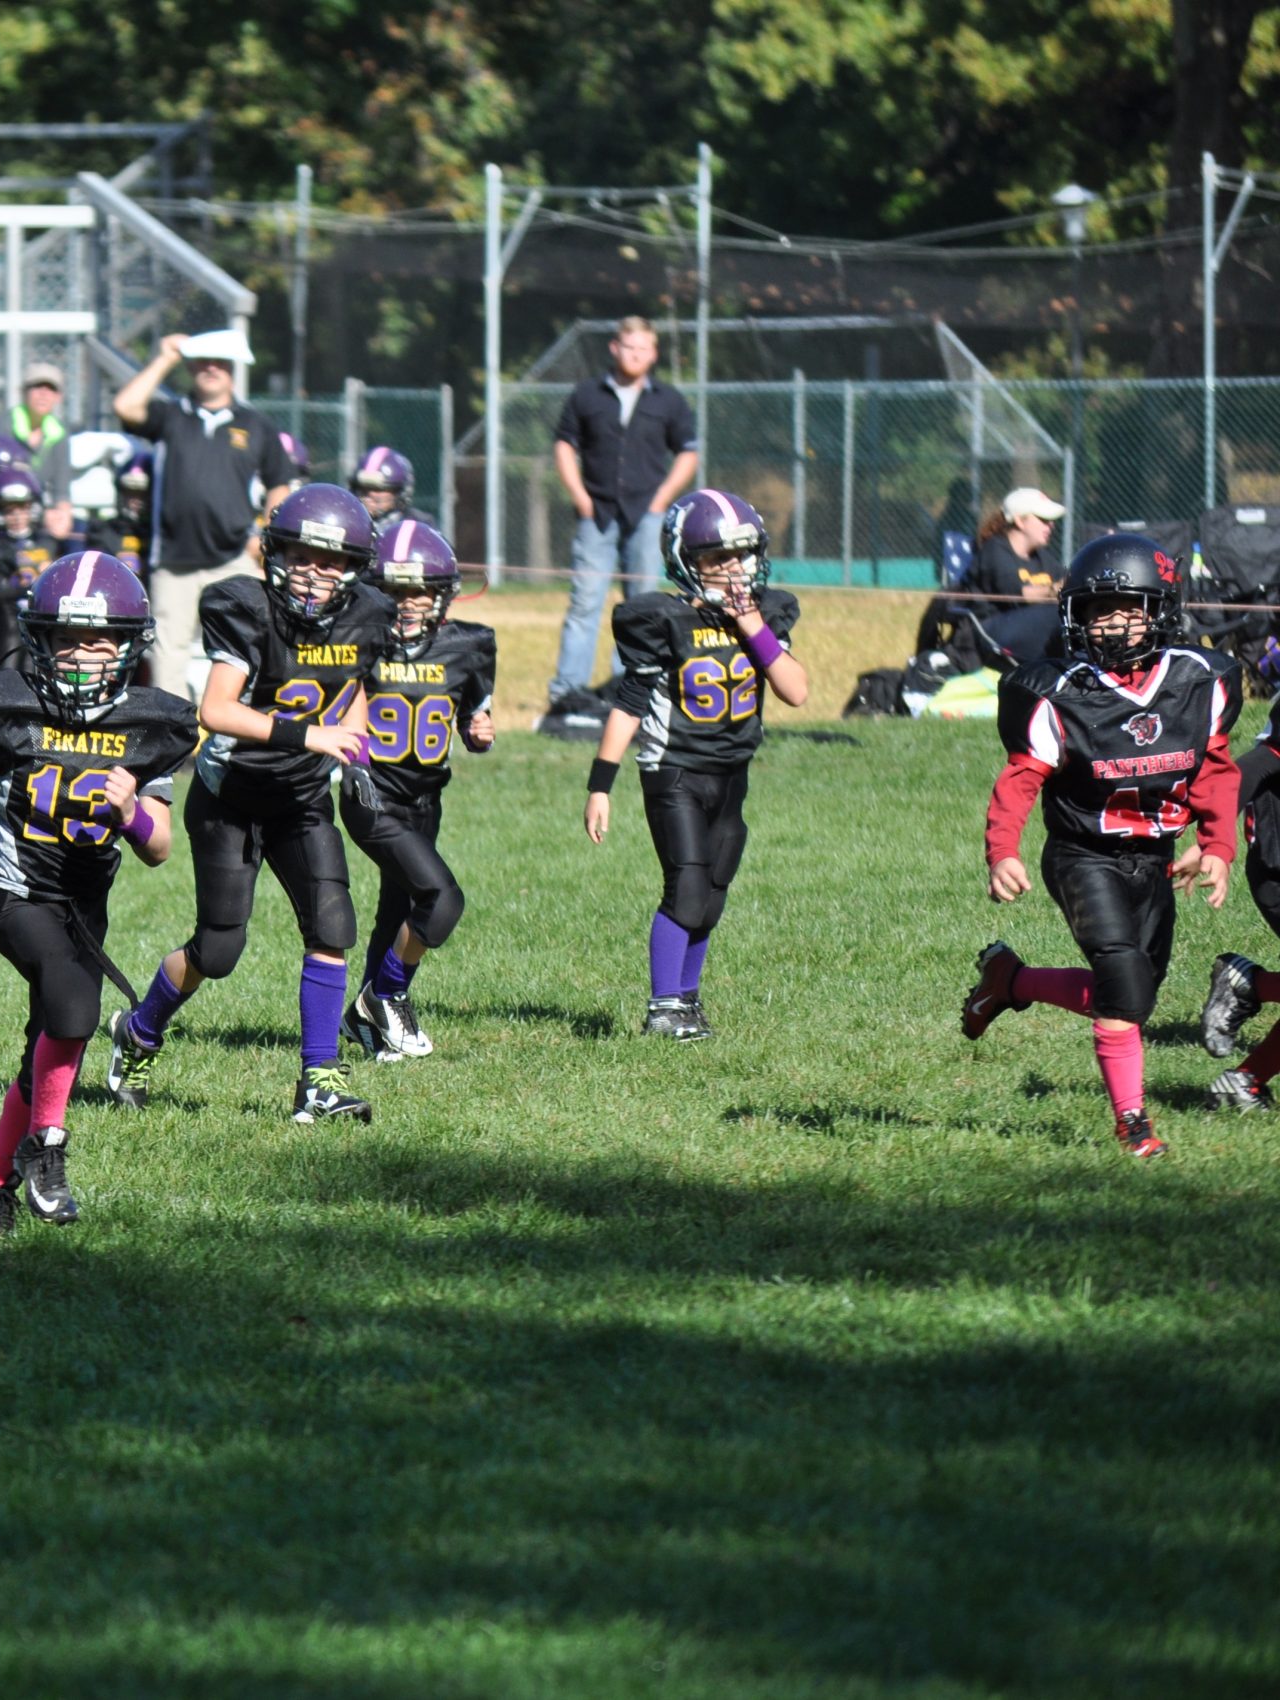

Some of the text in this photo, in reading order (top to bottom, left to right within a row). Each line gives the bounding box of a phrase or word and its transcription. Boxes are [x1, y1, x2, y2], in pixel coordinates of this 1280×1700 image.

[297, 644, 358, 666] PIRATES
[379, 662, 446, 684] PIRATES
[678, 652, 757, 722] 62
[41, 726, 127, 758] PIRATES
[368, 692, 456, 766] 96
[1091, 749, 1195, 779] PANTHERS
[23, 764, 111, 845] 13
